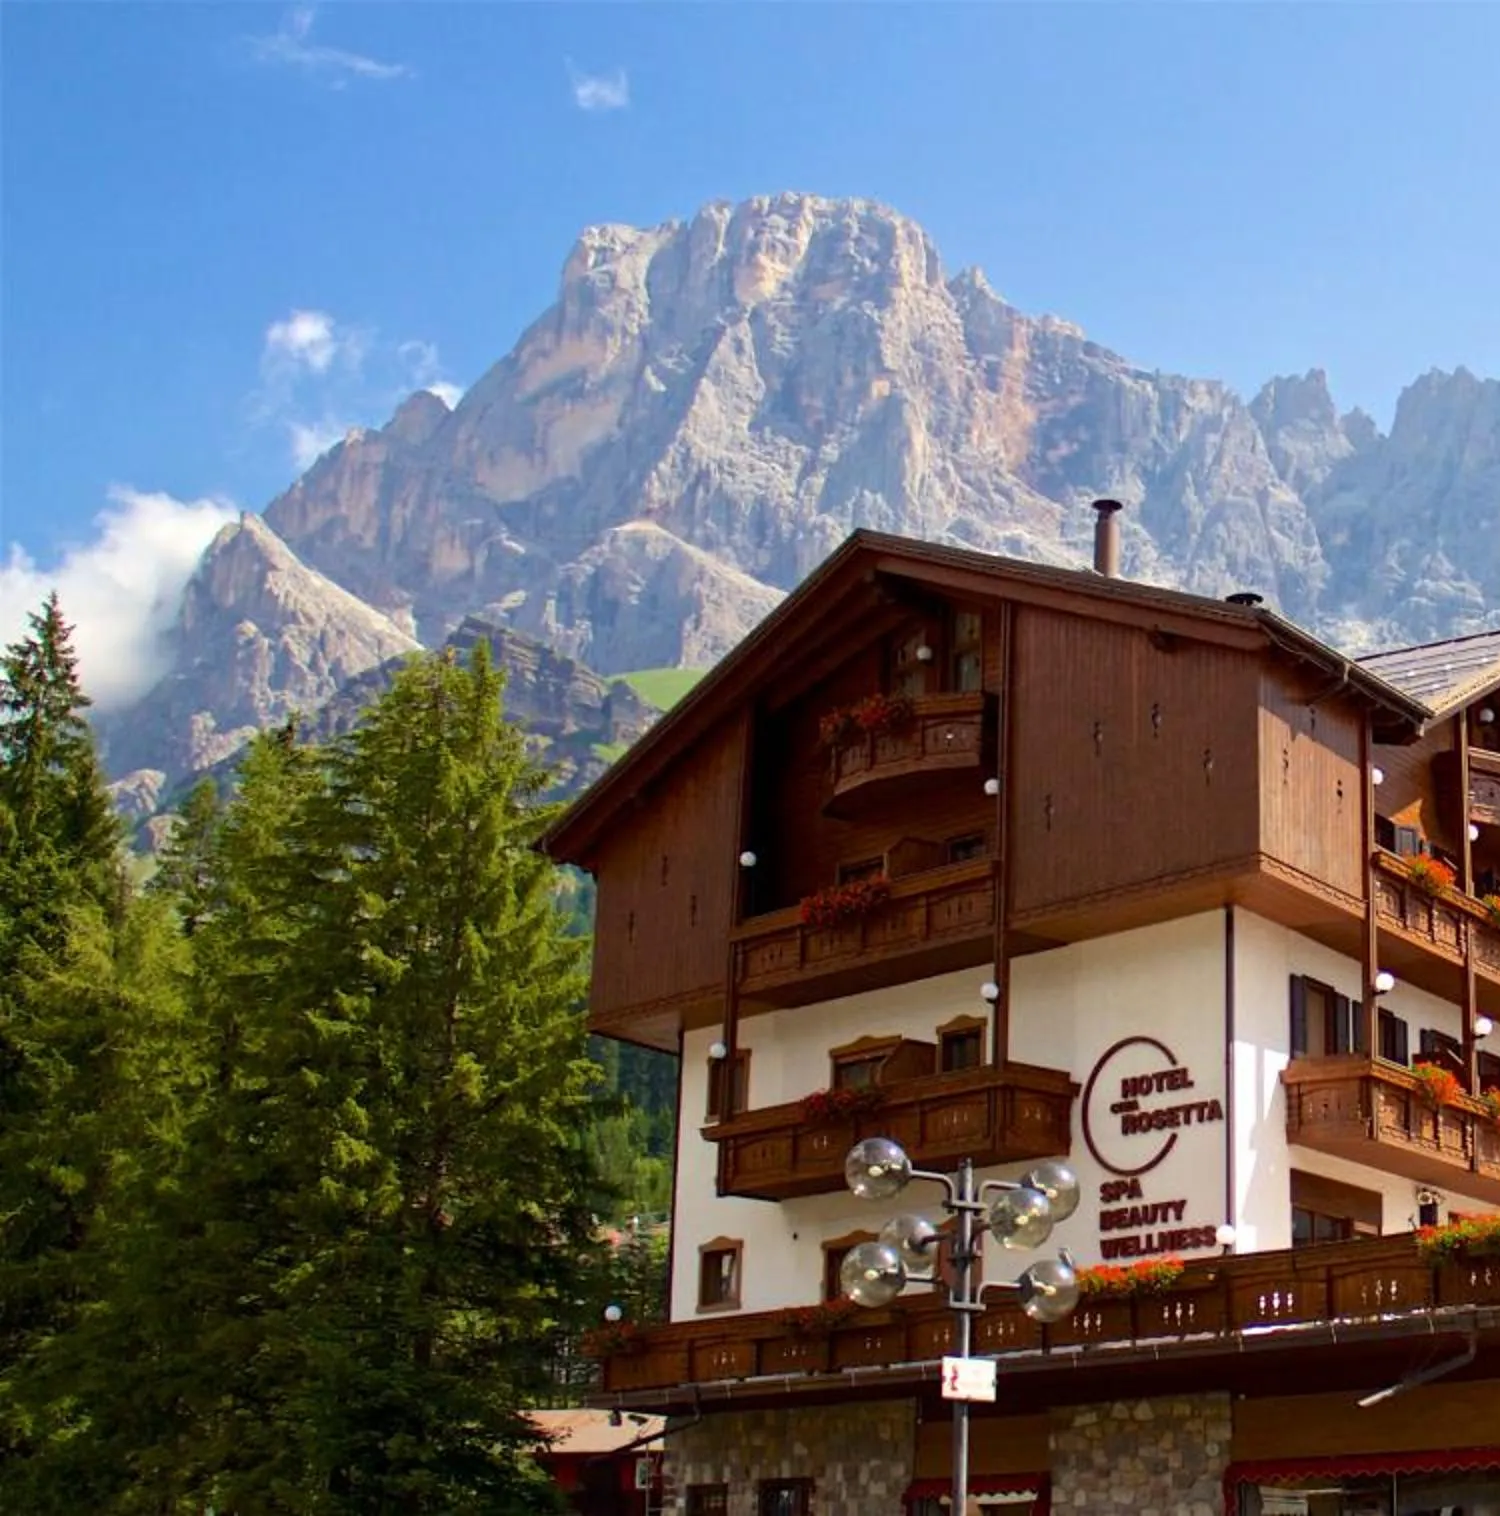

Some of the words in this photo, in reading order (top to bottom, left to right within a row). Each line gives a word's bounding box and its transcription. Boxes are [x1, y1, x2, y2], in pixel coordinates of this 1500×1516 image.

[1121, 1067, 1195, 1099] HOTEL
[1120, 1099, 1224, 1136] ROSETTA
[1099, 1178, 1144, 1203] SPA
[1099, 1199, 1188, 1232] BEAUTY
[1099, 1226, 1217, 1261] WELLNESS
